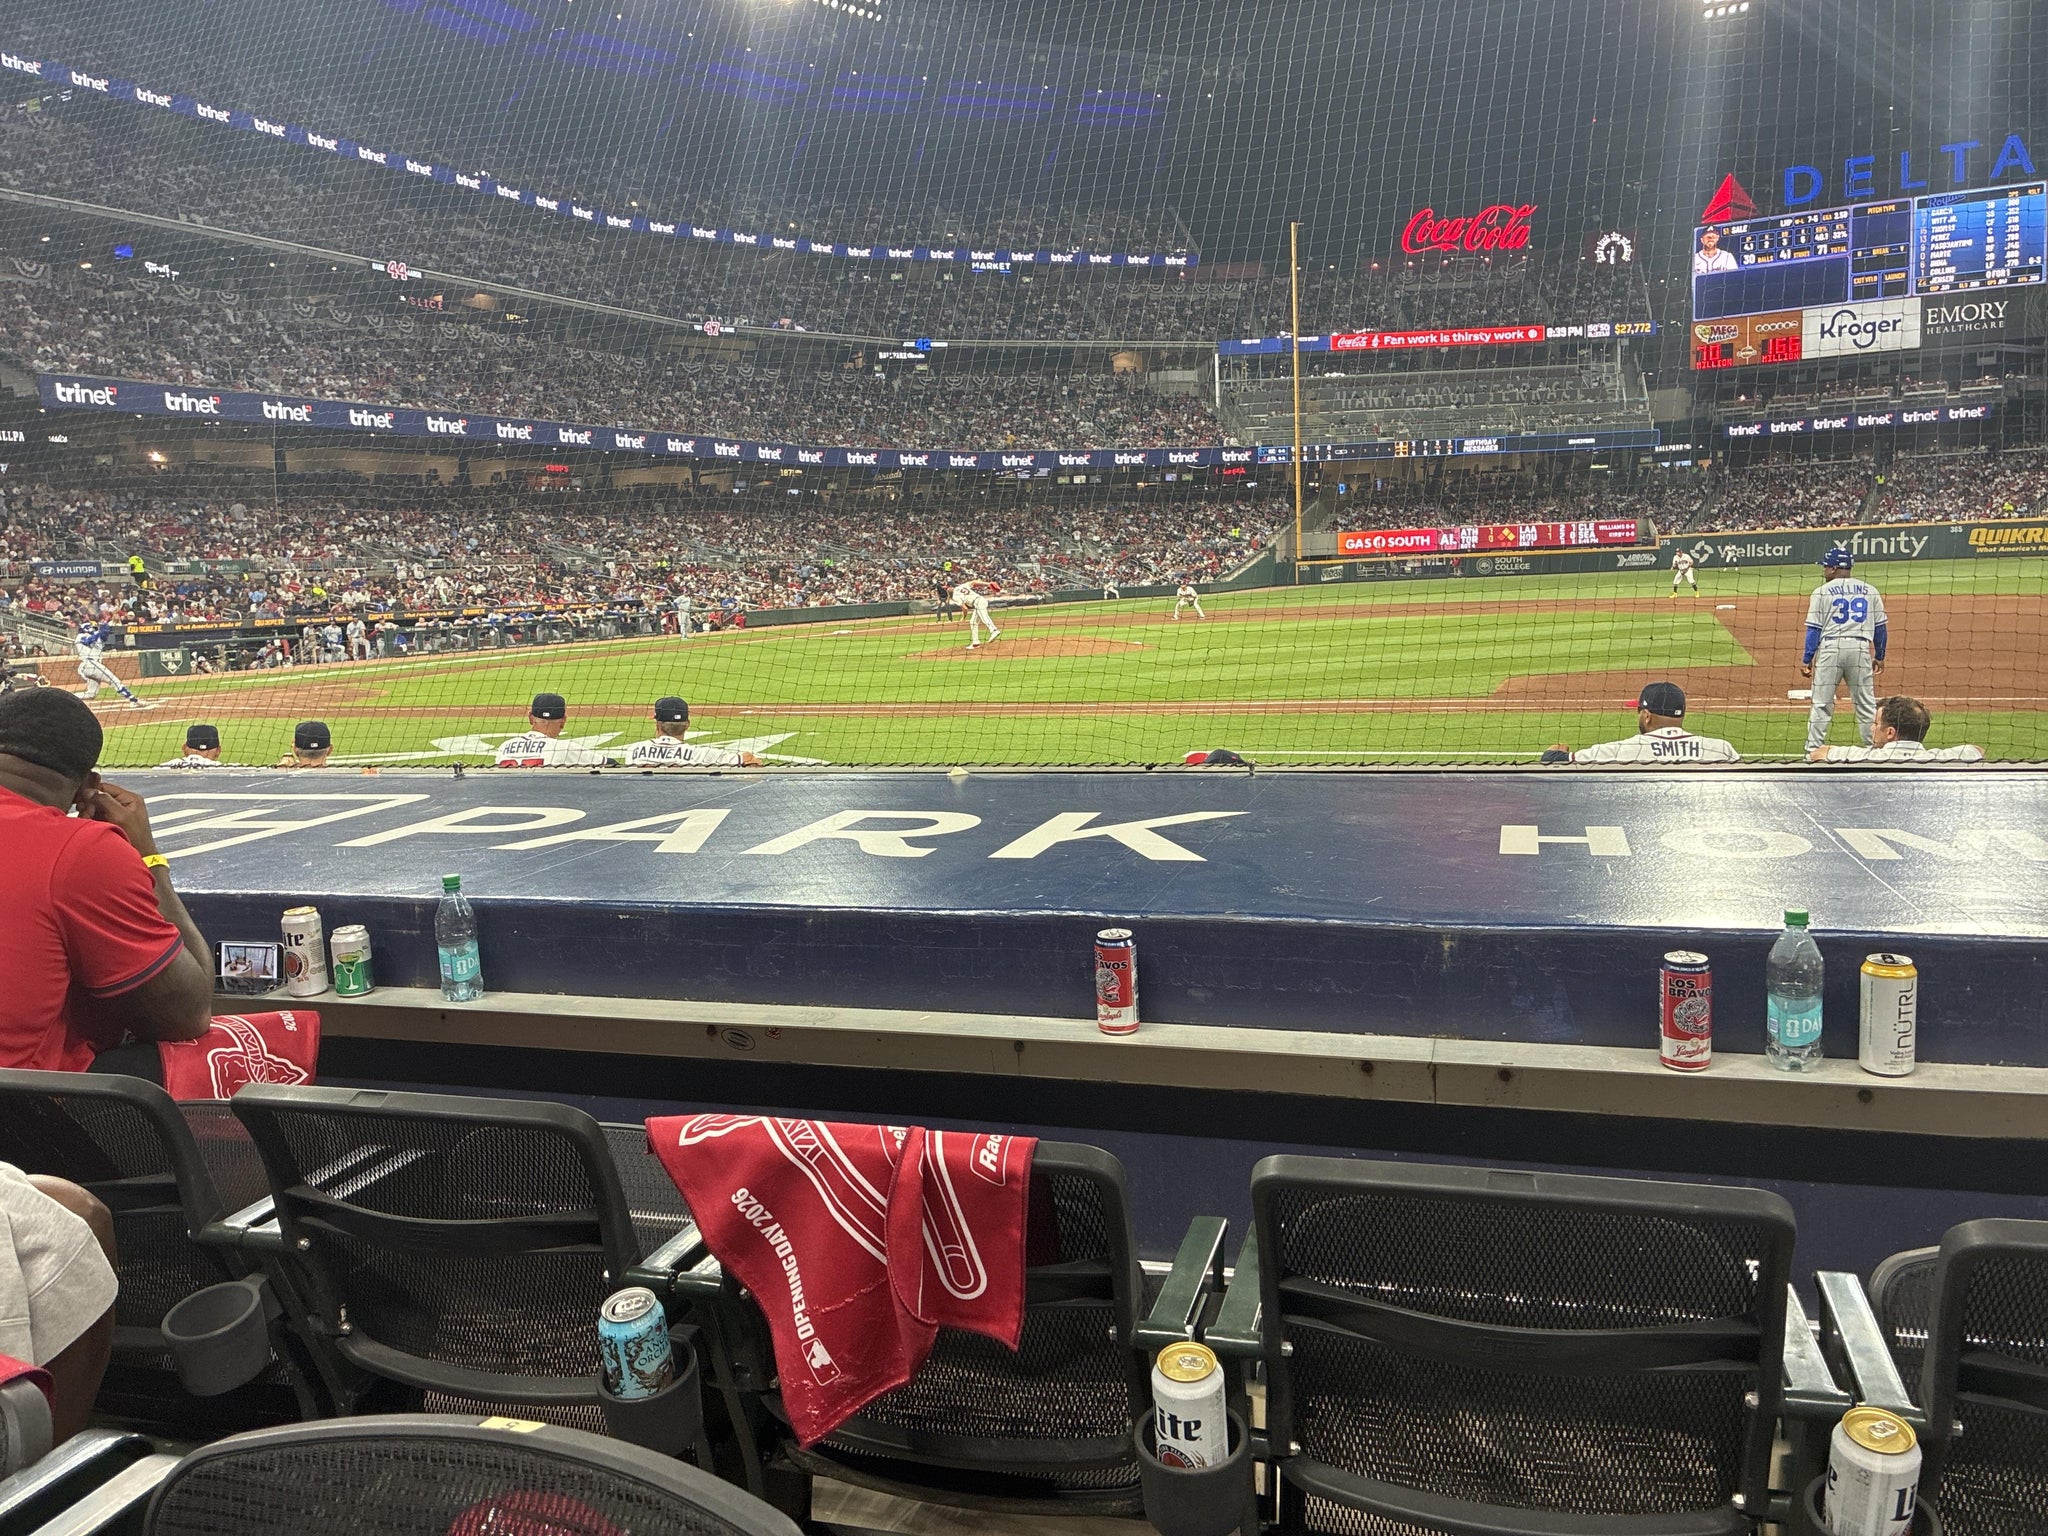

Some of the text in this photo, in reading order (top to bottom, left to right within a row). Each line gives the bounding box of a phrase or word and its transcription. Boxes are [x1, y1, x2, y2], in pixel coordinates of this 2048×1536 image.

[1, 53, 41, 74] trinet
[72, 71, 108, 91] trinet
[137, 88, 171, 107] trinet
[197, 104, 230, 122] trinet
[254, 119, 285, 136] trinet
[308, 133, 337, 150] trinet
[359, 147, 386, 163] trinet
[405, 159, 433, 177] trinet
[1784, 134, 2037, 206] DELTA
[455, 173, 481, 190] trinet
[496, 184, 521, 201] trinet
[535, 195, 558, 211] trinet
[572, 205, 594, 221] trinet
[606, 215, 632, 228] trinet
[649, 221, 675, 234] trinet
[1931, 217, 1947, 225] WITT
[692, 227, 717, 239] trinet
[1402, 204, 1537, 253] Coca-Cola
[1732, 225, 1748, 233] SALE
[733, 232, 757, 244] trinet
[772, 237, 796, 249] trinet
[1930, 234, 1950, 242] PEREZ
[811, 242, 833, 254] trinet
[847, 247, 871, 257] trinet
[888, 248, 913, 258] trinet
[930, 249, 954, 260] trinet
[970, 250, 995, 261] trinet
[1011, 252, 1035, 262] trinet
[1050, 253, 1074, 263] trinet
[1089, 254, 1112, 264] trinet
[1127, 255, 1150, 265] trinet
[1165, 256, 1187, 266] trinet
[1743, 255, 1756, 264] 30
[1779, 250, 1791, 259] 41
[387, 261, 408, 280] 44
[971, 262, 1011, 272] MARKET
[409, 296, 444, 311] SLICE
[1927, 301, 2008, 327] EMORY
[704, 315, 720, 335] 47
[1615, 323, 1651, 335] $27,772
[1710, 325, 1737, 334] MEGA
[1820, 309, 1902, 349] Kroger
[1927, 321, 2005, 335] HEALTHCARE
[1547, 327, 1566, 338] 8:39
[1568, 326, 1583, 336] PM
[914, 338, 931, 350] 42
[1338, 331, 1524, 348] Coca-Cola Fan work is thirsty work
[1768, 336, 1800, 354] 166
[1697, 344, 1720, 360] 70
[1762, 352, 1799, 363] MILLION
[1697, 359, 1732, 369] MILLION
[56, 383, 116, 405] trinet
[1336, 381, 1585, 409] HANK AARON TERRACE
[165, 392, 219, 413] trinet
[263, 401, 311, 421] trinet
[1902, 410, 1939, 423] trinet
[1948, 406, 1985, 420] trinet
[350, 409, 393, 428] trinet
[1813, 417, 1848, 430] trinet
[1857, 413, 1893, 427] trinet
[427, 417, 466, 434] trinet
[497, 423, 531, 439] trinet
[1728, 424, 1761, 436] trinet
[1770, 421, 1804, 433] trinet
[558, 428, 592, 445] trinet
[615, 433, 646, 449] trinet
[1464, 438, 1497, 446] BIRTHDAY
[667, 438, 695, 453] trinet
[714, 442, 740, 457] trinet
[1463, 445, 1499, 453] MESSAGES
[758, 446, 782, 460] trinet
[798, 450, 823, 464] trinet
[846, 451, 877, 465] trinet
[899, 453, 929, 466] trinet
[1058, 453, 1091, 466] trinet
[1114, 452, 1146, 465] trinet
[1168, 451, 1199, 463] trinet
[1222, 450, 1251, 463] trinet
[949, 454, 977, 467] trinet
[1001, 454, 1034, 467] trinet
[1461, 528, 1478, 536] ATH
[1520, 525, 1537, 533] LAA
[1578, 523, 1595, 531] CLE
[1440, 534, 1457, 545] AL
[1461, 536, 1478, 544] TOR
[1520, 532, 1537, 541] HOU
[1578, 531, 1596, 539] SEA
[1346, 535, 1430, 549] GAS SOUTH
[1833, 530, 1929, 558] xfinity
[1999, 545, 2036, 553] America's
[1494, 556, 1523, 564] SOUTH
[1494, 562, 1531, 571] COLLEGE
[56, 565, 97, 575] HYUNDAI
[1828, 584, 1869, 597] HOLLINS
[1832, 597, 1868, 624] 39
[161, 651, 182, 661] MLB
[503, 740, 545, 755] HEFNER
[632, 746, 692, 761] GARNEAU
[1651, 741, 1700, 758] SMITH
[335, 807, 1250, 862] PARK
[284, 932, 304, 950] ite
[1668, 978, 1696, 989] LOS
[1668, 987, 1712, 998] BRAVO
[281, 1012, 298, 1032] 2026
[1802, 1018, 1821, 1033] DA
[731, 1187, 815, 1341] OPENING DAY 2026
